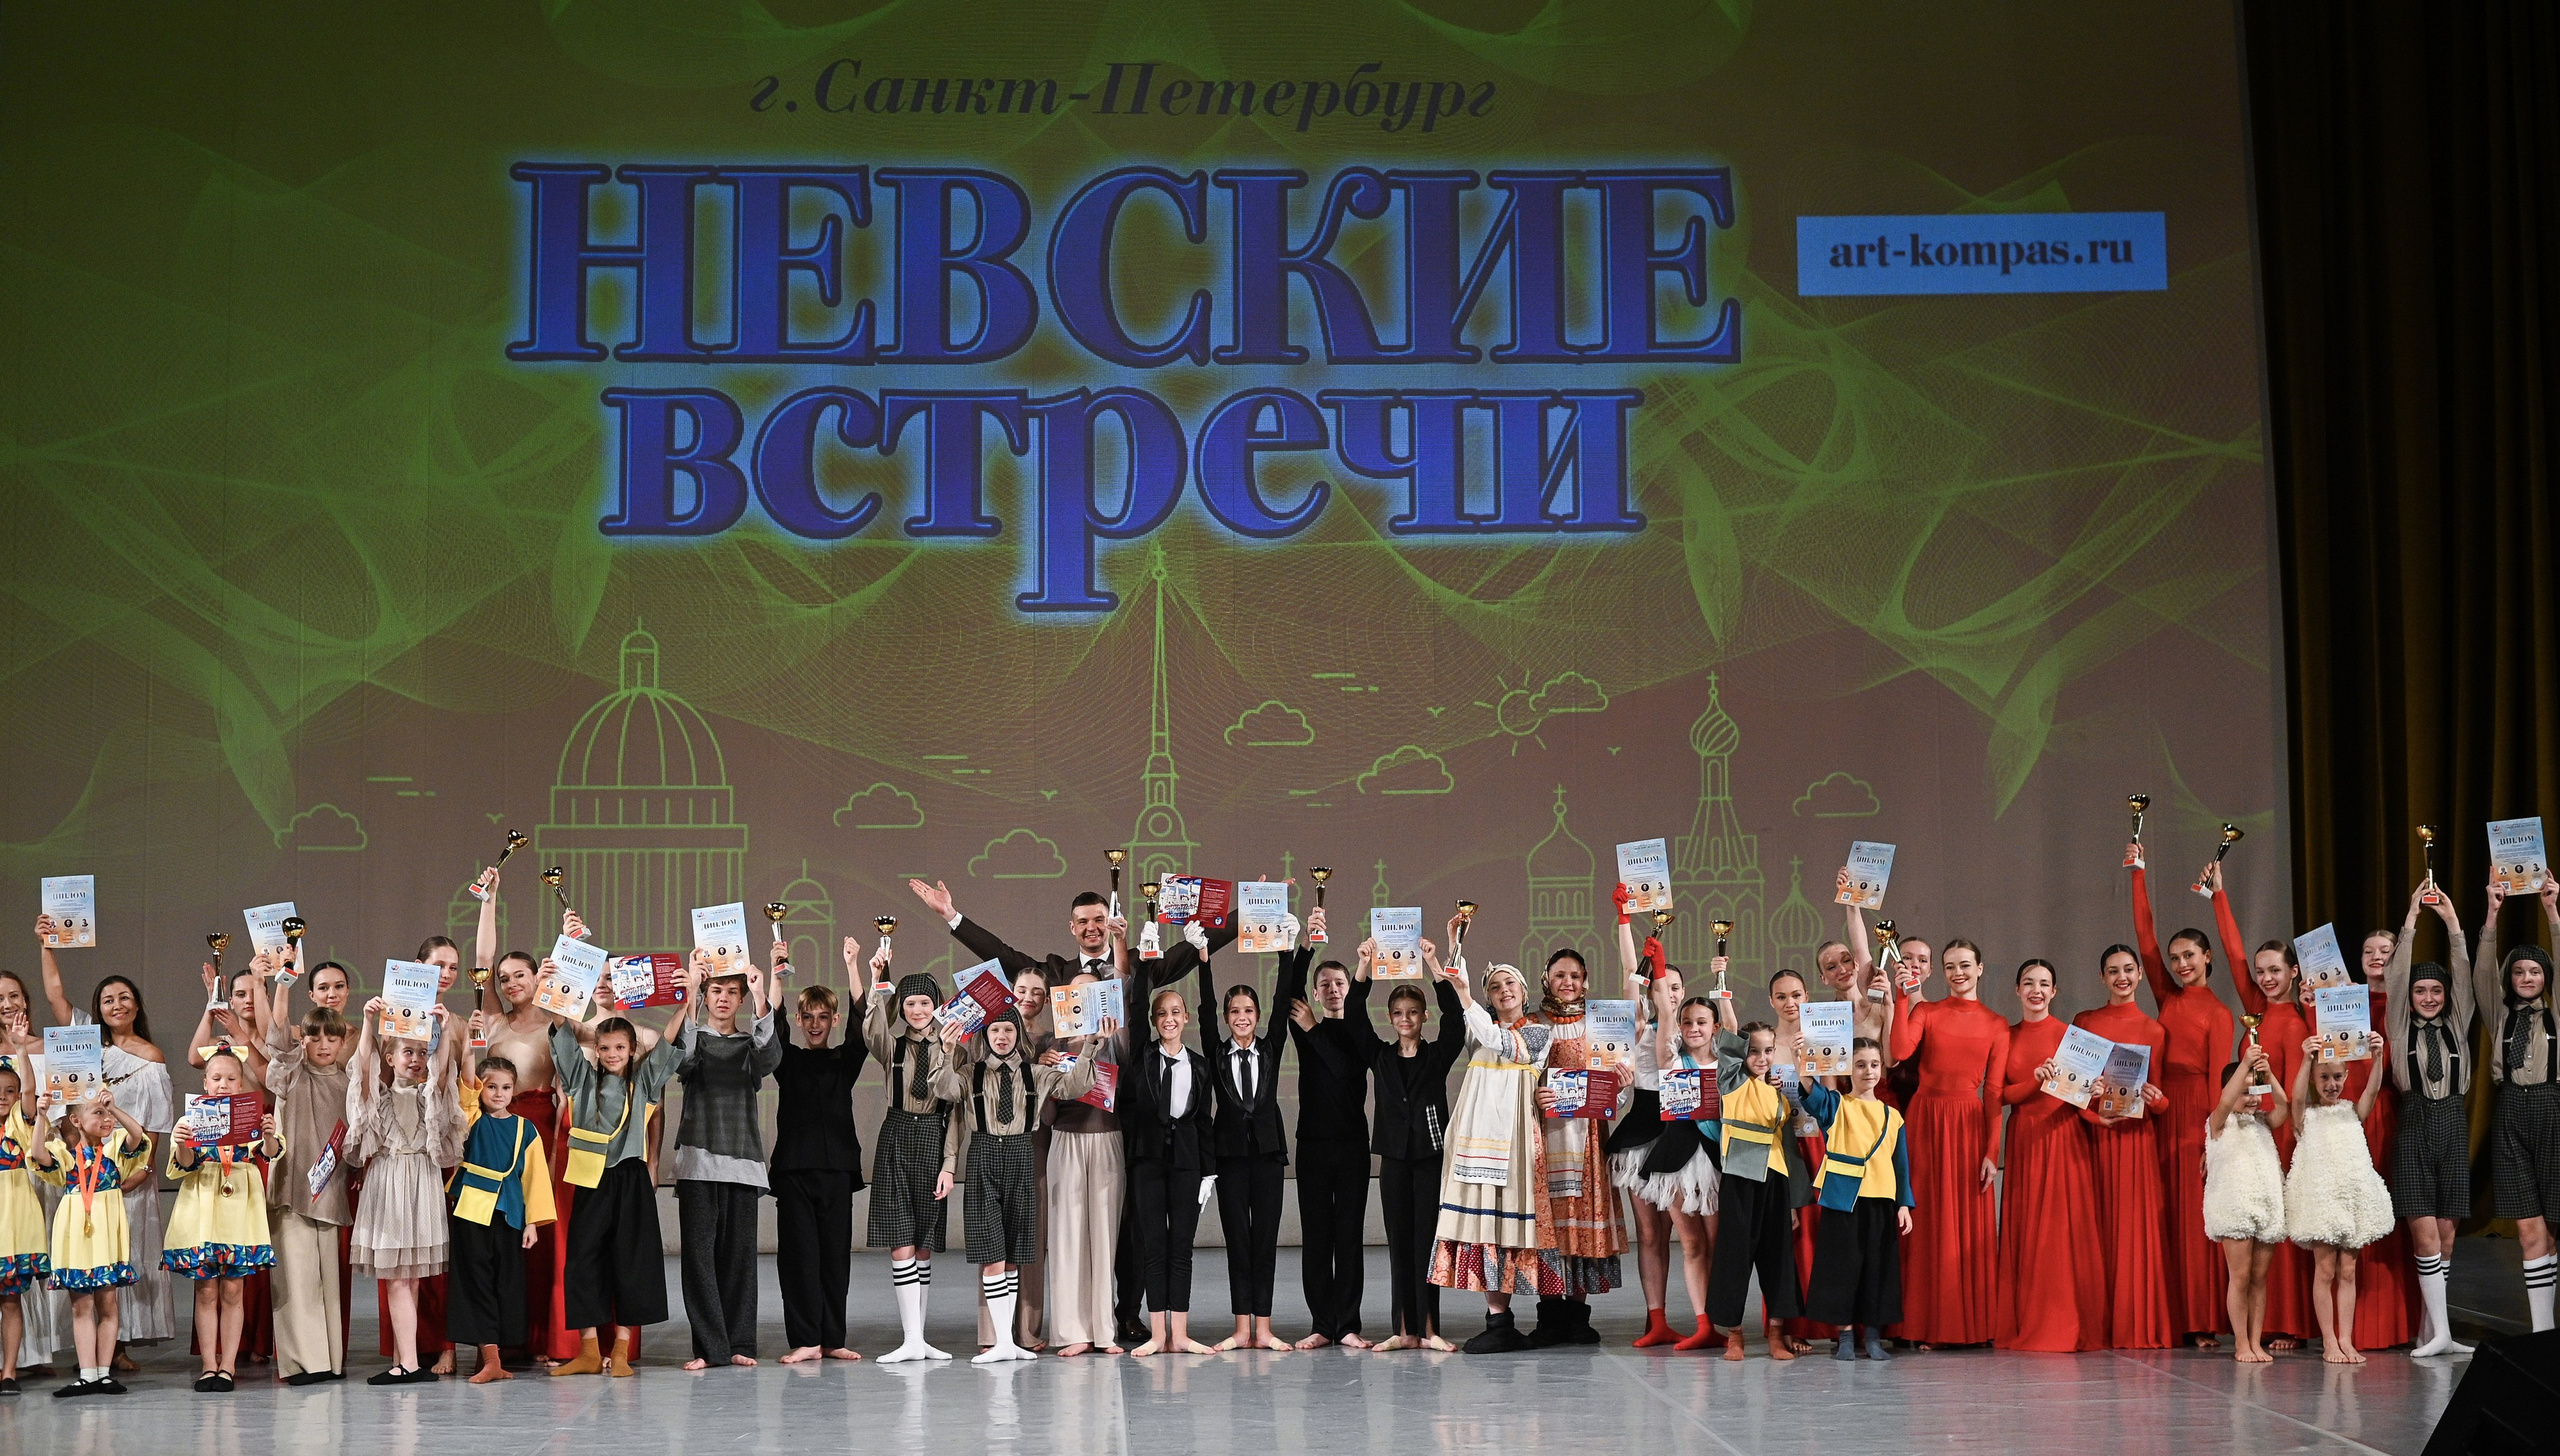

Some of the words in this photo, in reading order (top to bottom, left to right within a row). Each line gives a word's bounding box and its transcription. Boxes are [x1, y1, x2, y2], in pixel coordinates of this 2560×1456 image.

[1829, 233, 2134, 275] art-kompas.ru
[505, 161, 1742, 366] НЕВСКИЕ
[2497, 835, 2534, 846] ДИПЛОМ
[1625, 855, 1659, 867] ДИПЛОМ
[1246, 898, 1280, 906] ДИПЛОМ
[1379, 923, 1414, 932] ДИПЛОМ
[392, 978, 430, 989] ДИПЛОМ
[2324, 1002, 2361, 1013] ДИПЛОМ
[1593, 1015, 1628, 1023] ДИПЛОМ
[1809, 1019, 1845, 1028] ДИПЛОМ
[53, 1043, 92, 1053] ДИПЛОМ
